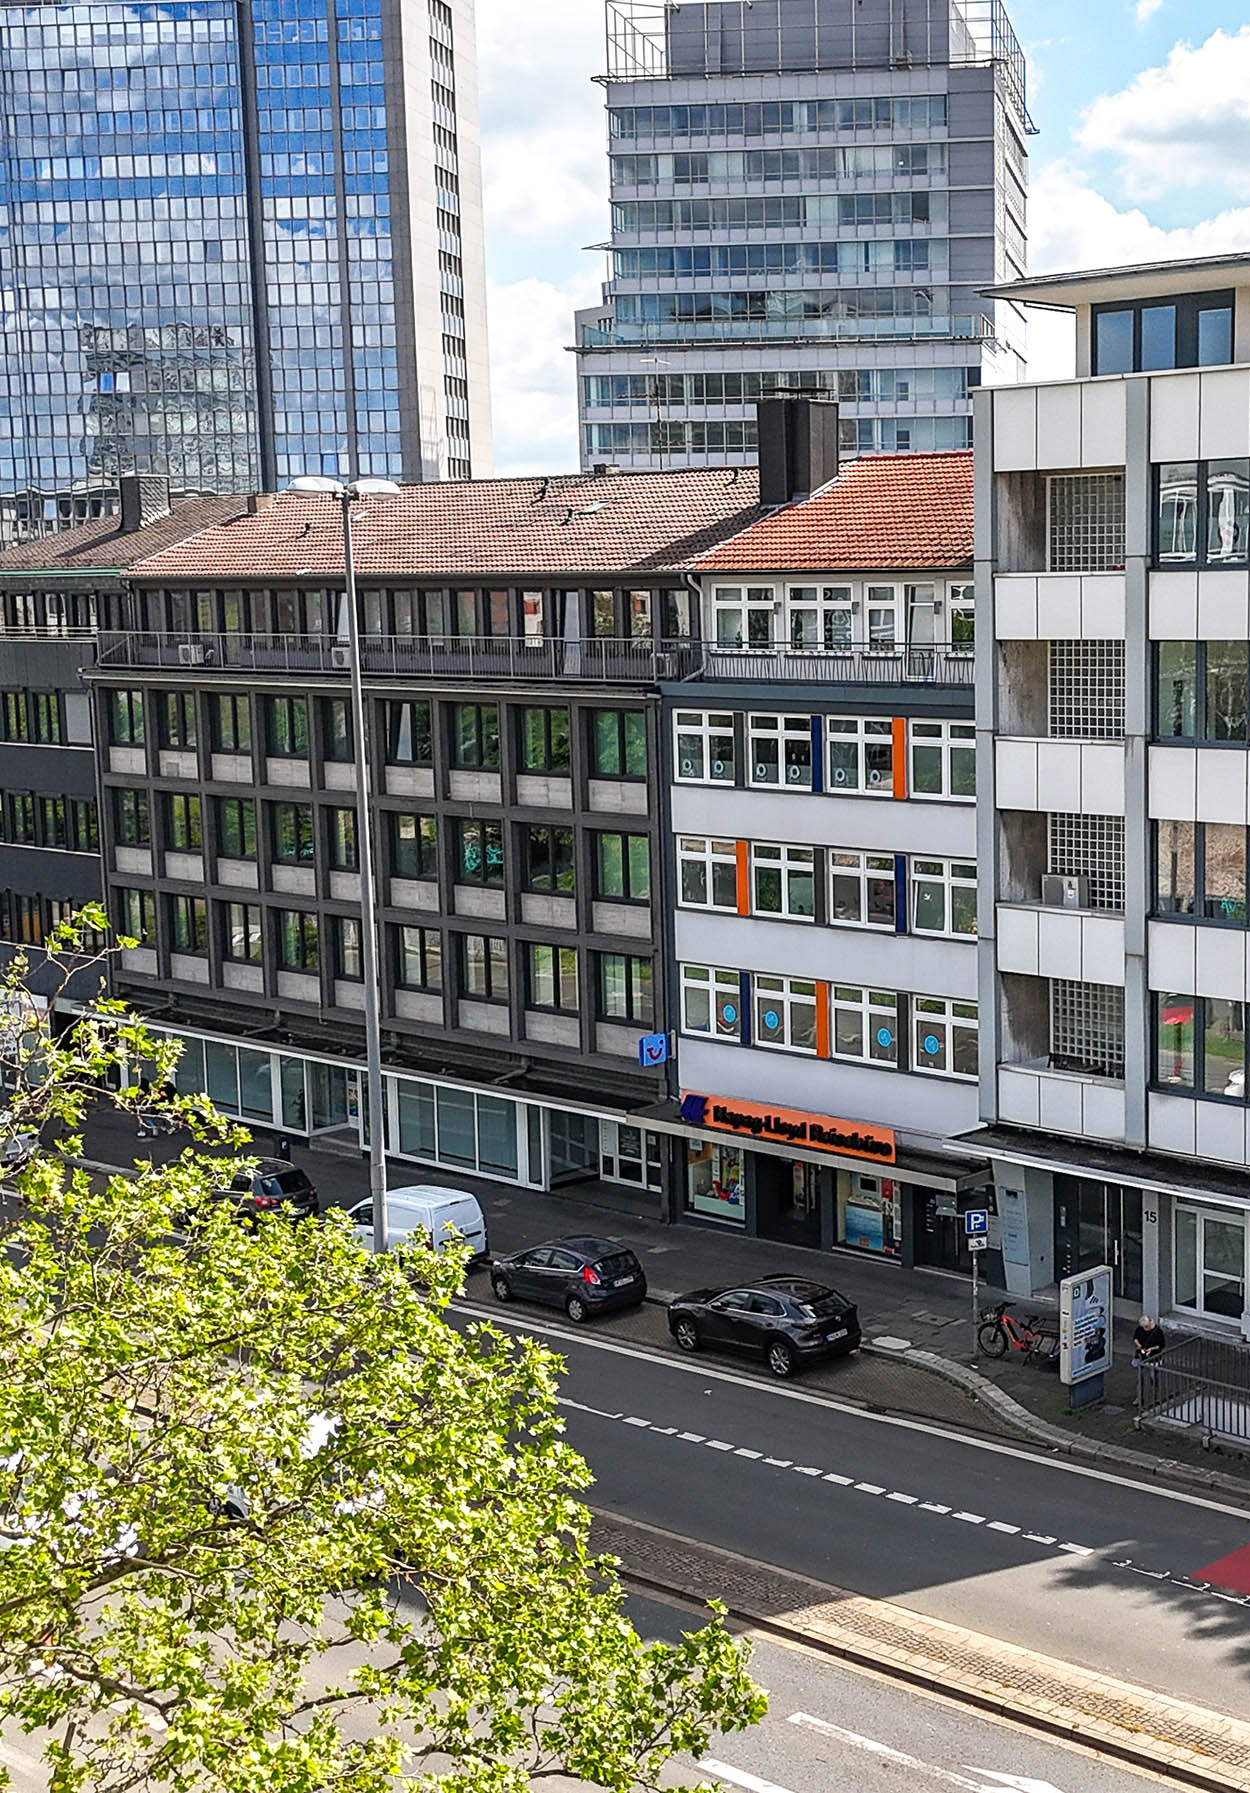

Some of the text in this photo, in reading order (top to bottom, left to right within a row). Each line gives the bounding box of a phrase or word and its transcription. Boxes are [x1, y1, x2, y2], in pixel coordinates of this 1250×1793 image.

[713, 1105, 806, 1140] Hapag-Lloyd
[970, 1213, 982, 1231] P
[1144, 1209, 1157, 1224] 15
